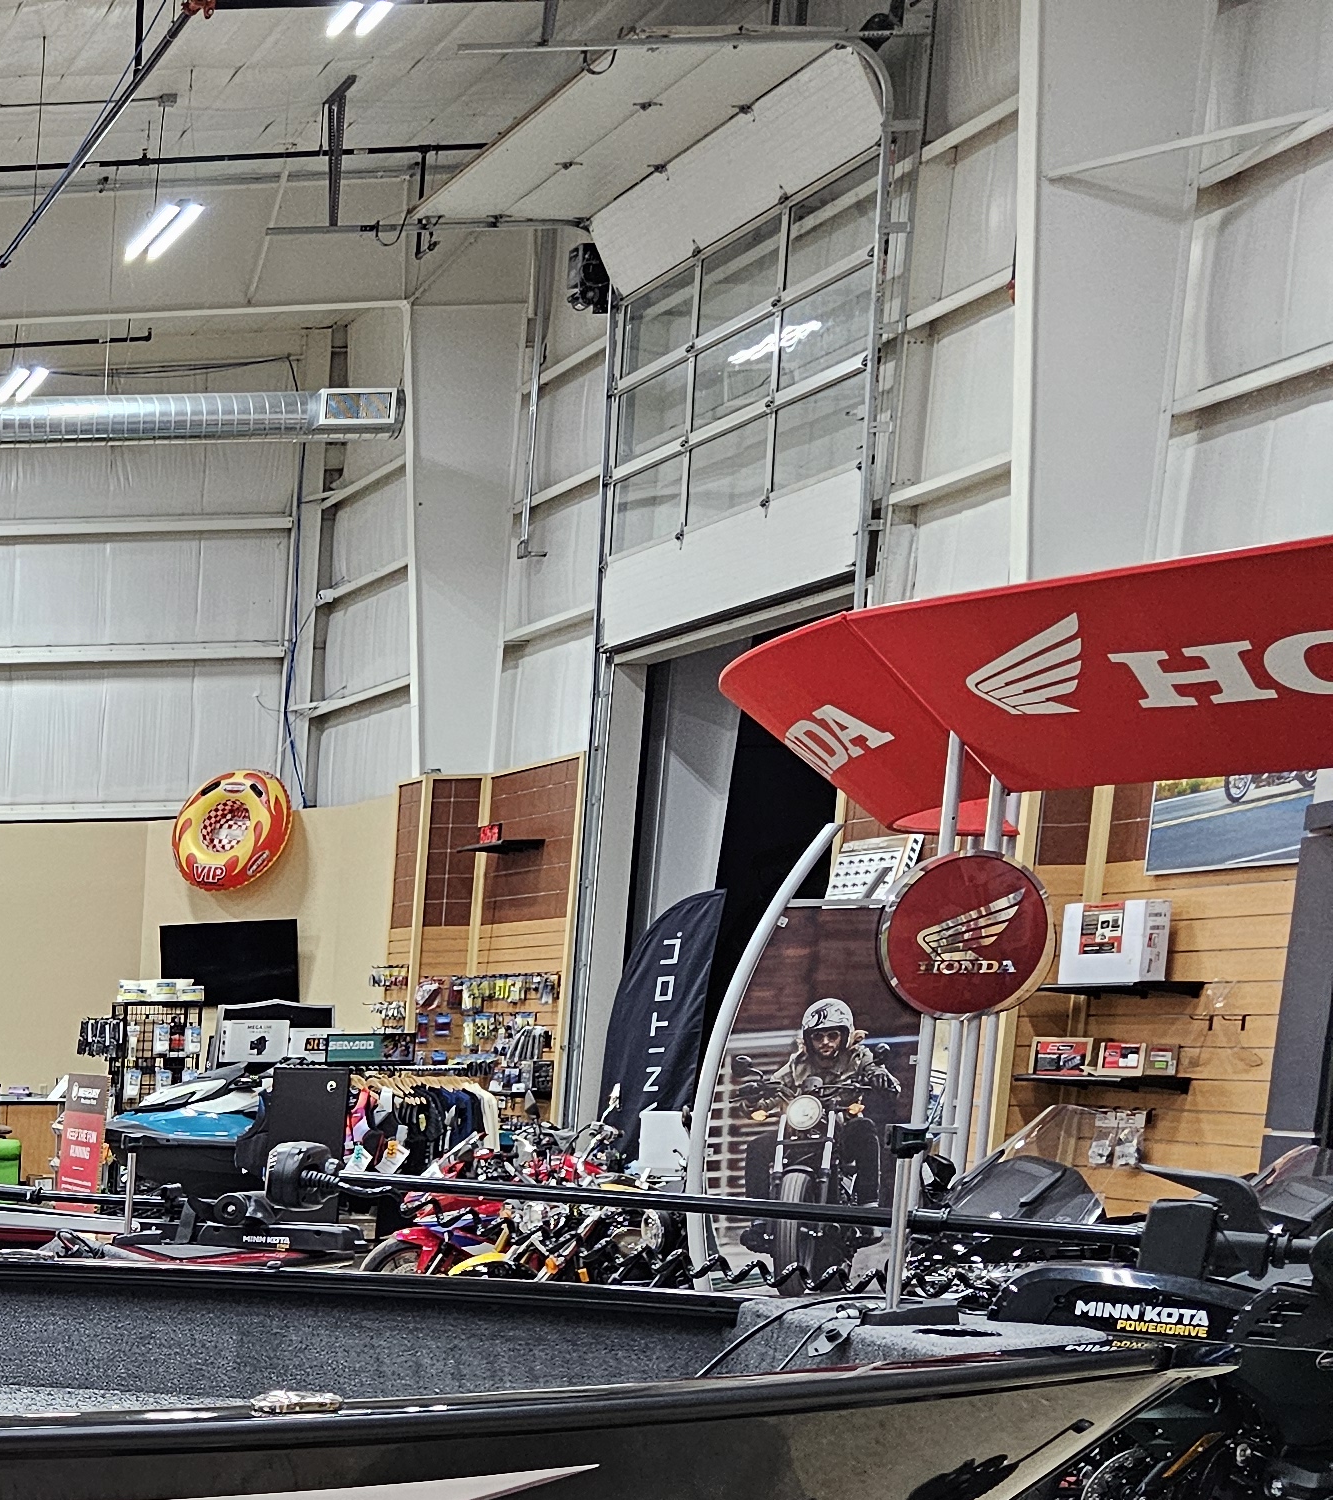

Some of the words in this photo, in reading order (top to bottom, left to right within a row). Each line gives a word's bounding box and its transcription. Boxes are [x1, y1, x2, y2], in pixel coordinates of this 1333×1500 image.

[193, 863, 226, 883] VIP
[916, 960, 1017, 975] HONDA
[1074, 1300, 1141, 1319] MINN
[1144, 1305, 1210, 1327] KOTA
[1116, 1319, 1209, 1338] POWERDRIVE
